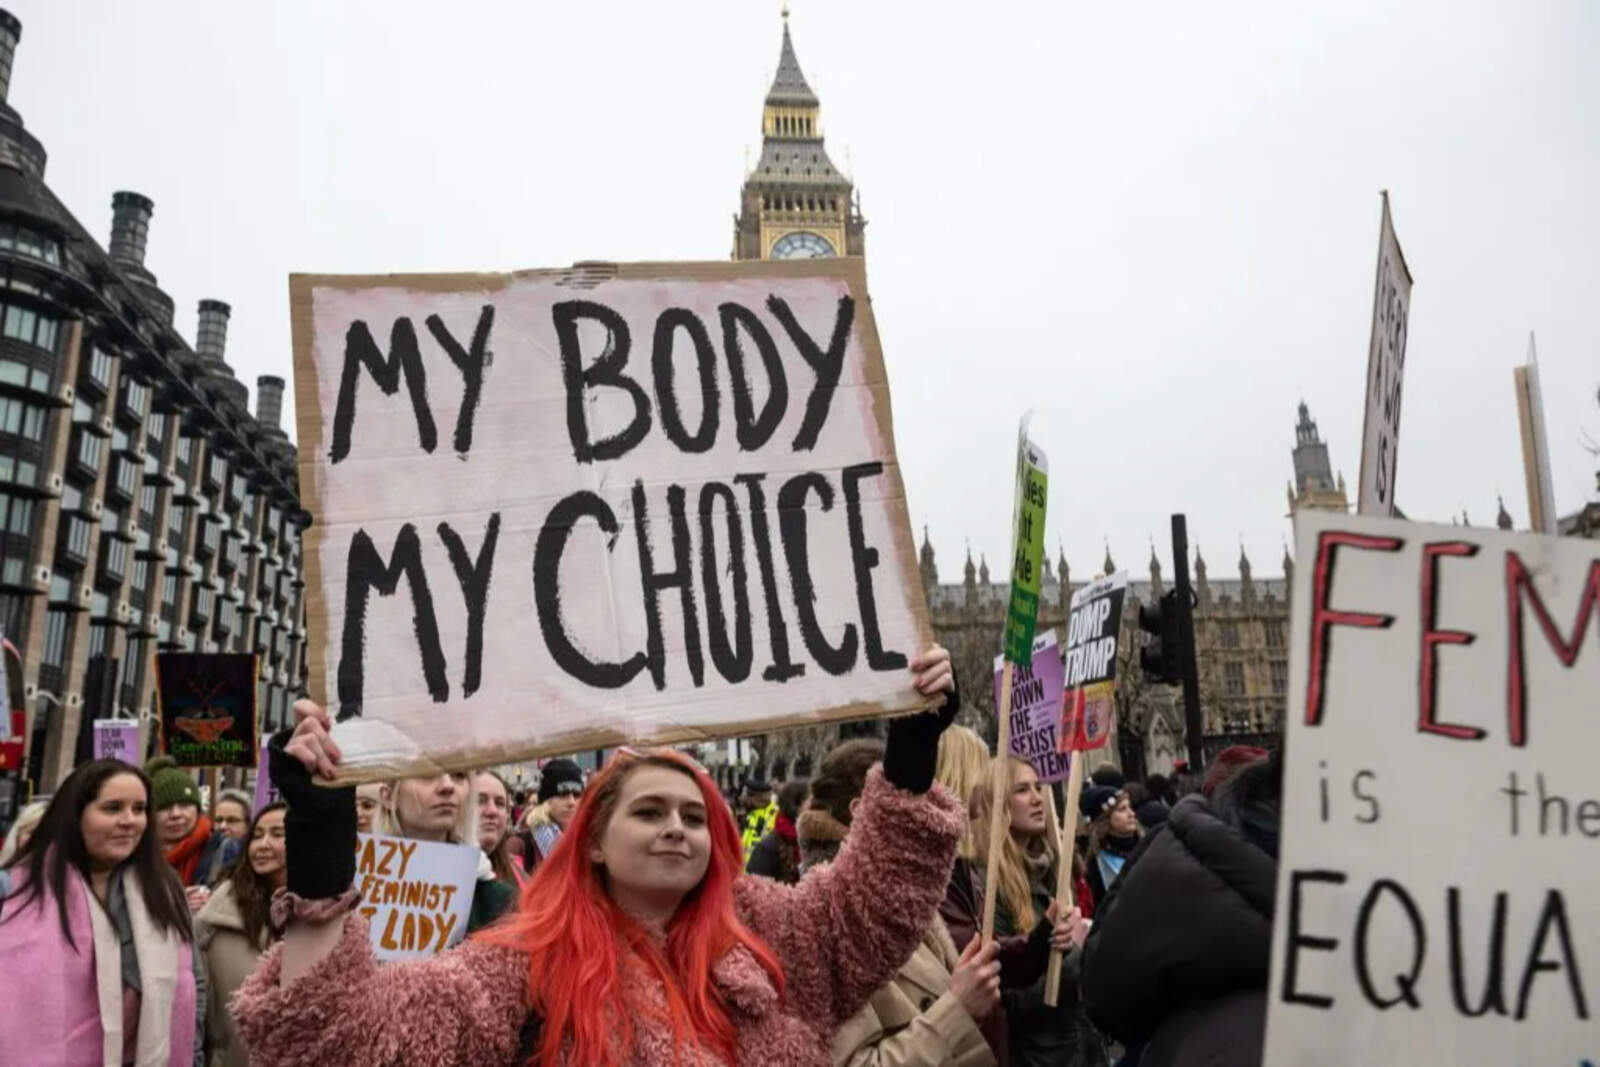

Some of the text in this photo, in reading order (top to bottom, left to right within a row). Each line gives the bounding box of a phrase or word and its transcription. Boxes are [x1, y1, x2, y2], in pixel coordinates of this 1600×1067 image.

[330, 294, 856, 463] MY BODY
[336, 461, 909, 724] MY CHOICE
[1068, 597, 1111, 649] DUMP
[1303, 531, 1600, 748] FEM
[1012, 663, 1034, 688] EAR
[1064, 635, 1116, 688] TRUMP
[1010, 677, 1044, 712] OWN
[1011, 724, 1056, 757] SEXIST
[1032, 751, 1070, 778] TEM
[1318, 760, 1600, 838] is the
[356, 838, 417, 880] AZY
[361, 874, 458, 913] FEMINIST
[380, 907, 457, 954] LADY
[1281, 869, 1591, 1022] EQUA
